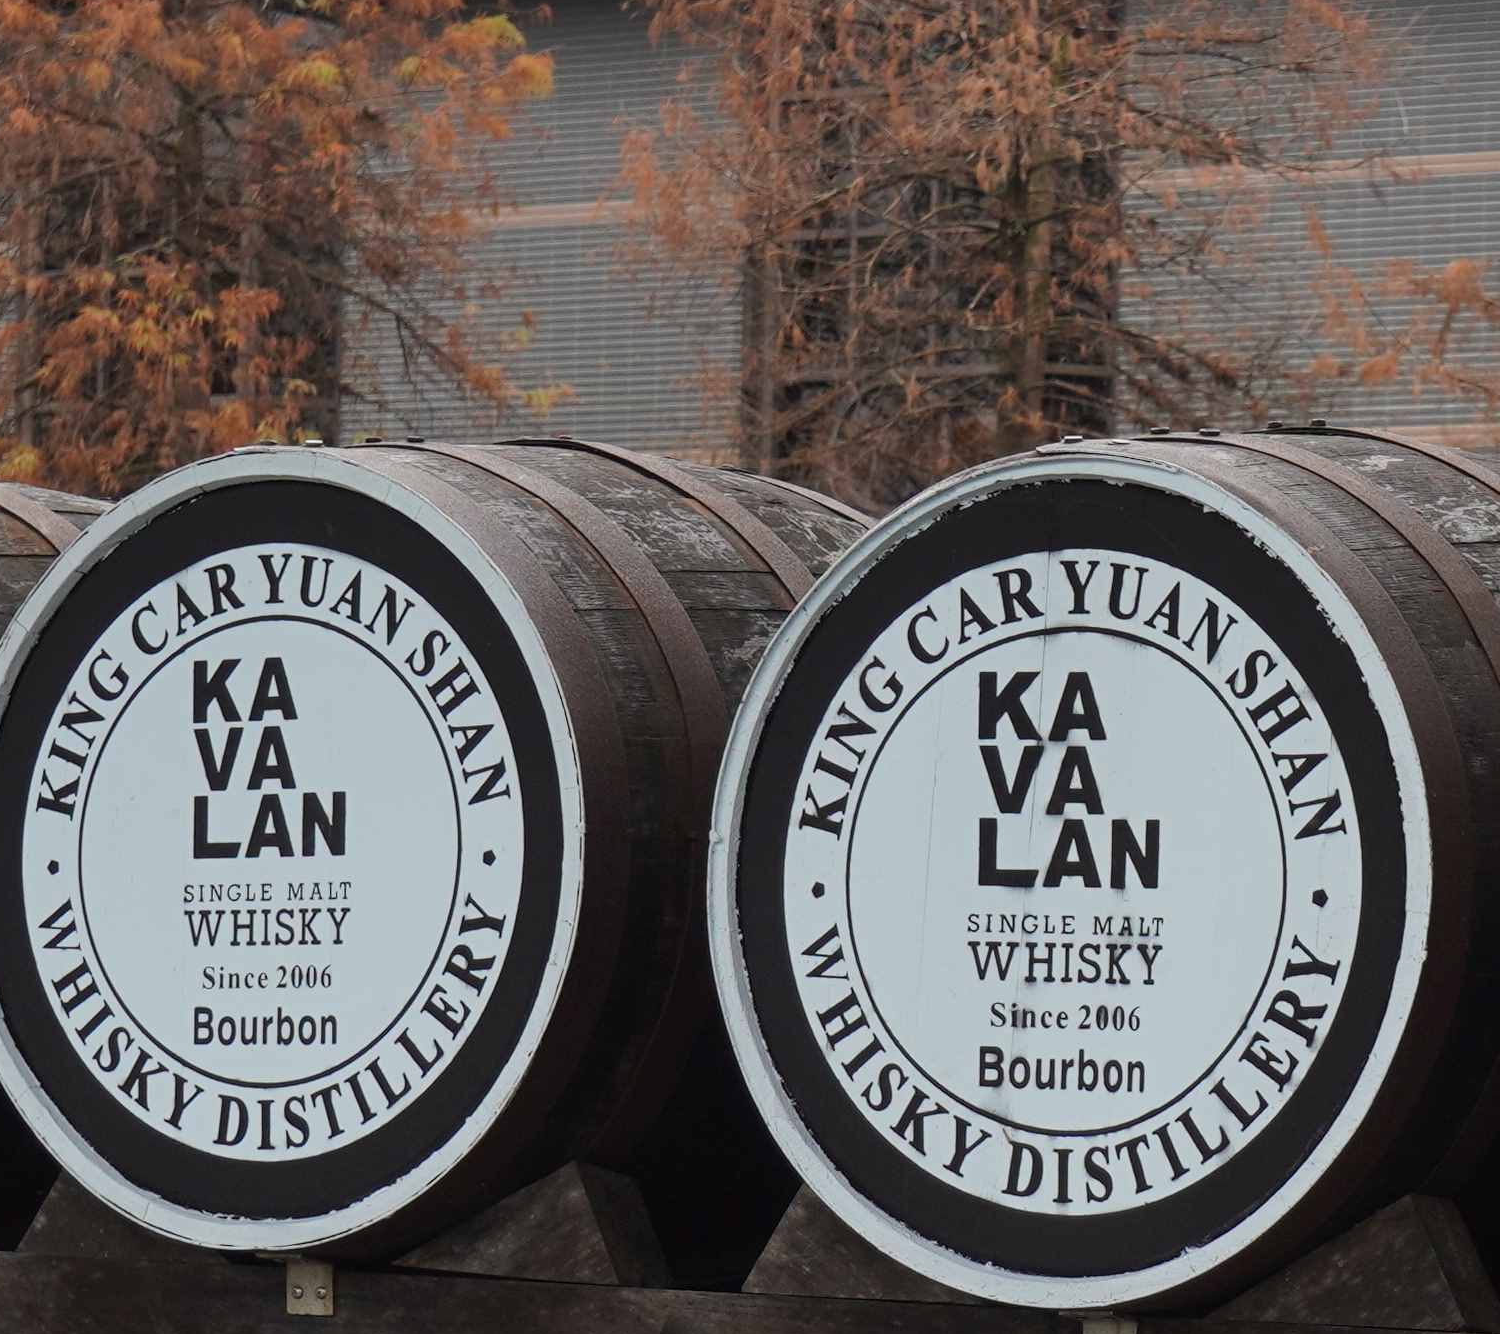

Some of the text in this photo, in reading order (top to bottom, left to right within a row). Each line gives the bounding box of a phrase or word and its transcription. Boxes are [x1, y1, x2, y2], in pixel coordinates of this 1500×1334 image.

[36, 554, 510, 821] KING CAR YUAN SHAN
[193, 657, 298, 723] KA
[799, 561, 1347, 840] KING CAR YUAN SHAN
[978, 672, 1106, 743] KA
[194, 726, 296, 791] VA
[980, 743, 1104, 815] VA
[193, 792, 346, 859] LAN
[978, 818, 1160, 890] LAN
[184, 882, 351, 902] SINGLE MALT
[184, 908, 350, 946] WHISKY
[968, 914, 1163, 937] SINGLE MALT
[204, 965, 331, 988] Since 2006
[968, 941, 1162, 985] WHISKY
[39, 893, 506, 1150] WHISKY DISTILLERY
[194, 1007, 336, 1045] Bourbon
[991, 1003, 1140, 1031] Since 2006
[801, 923, 1340, 1204] WHISKY DISTILLERY
[979, 1046, 1144, 1093] Bourbon
